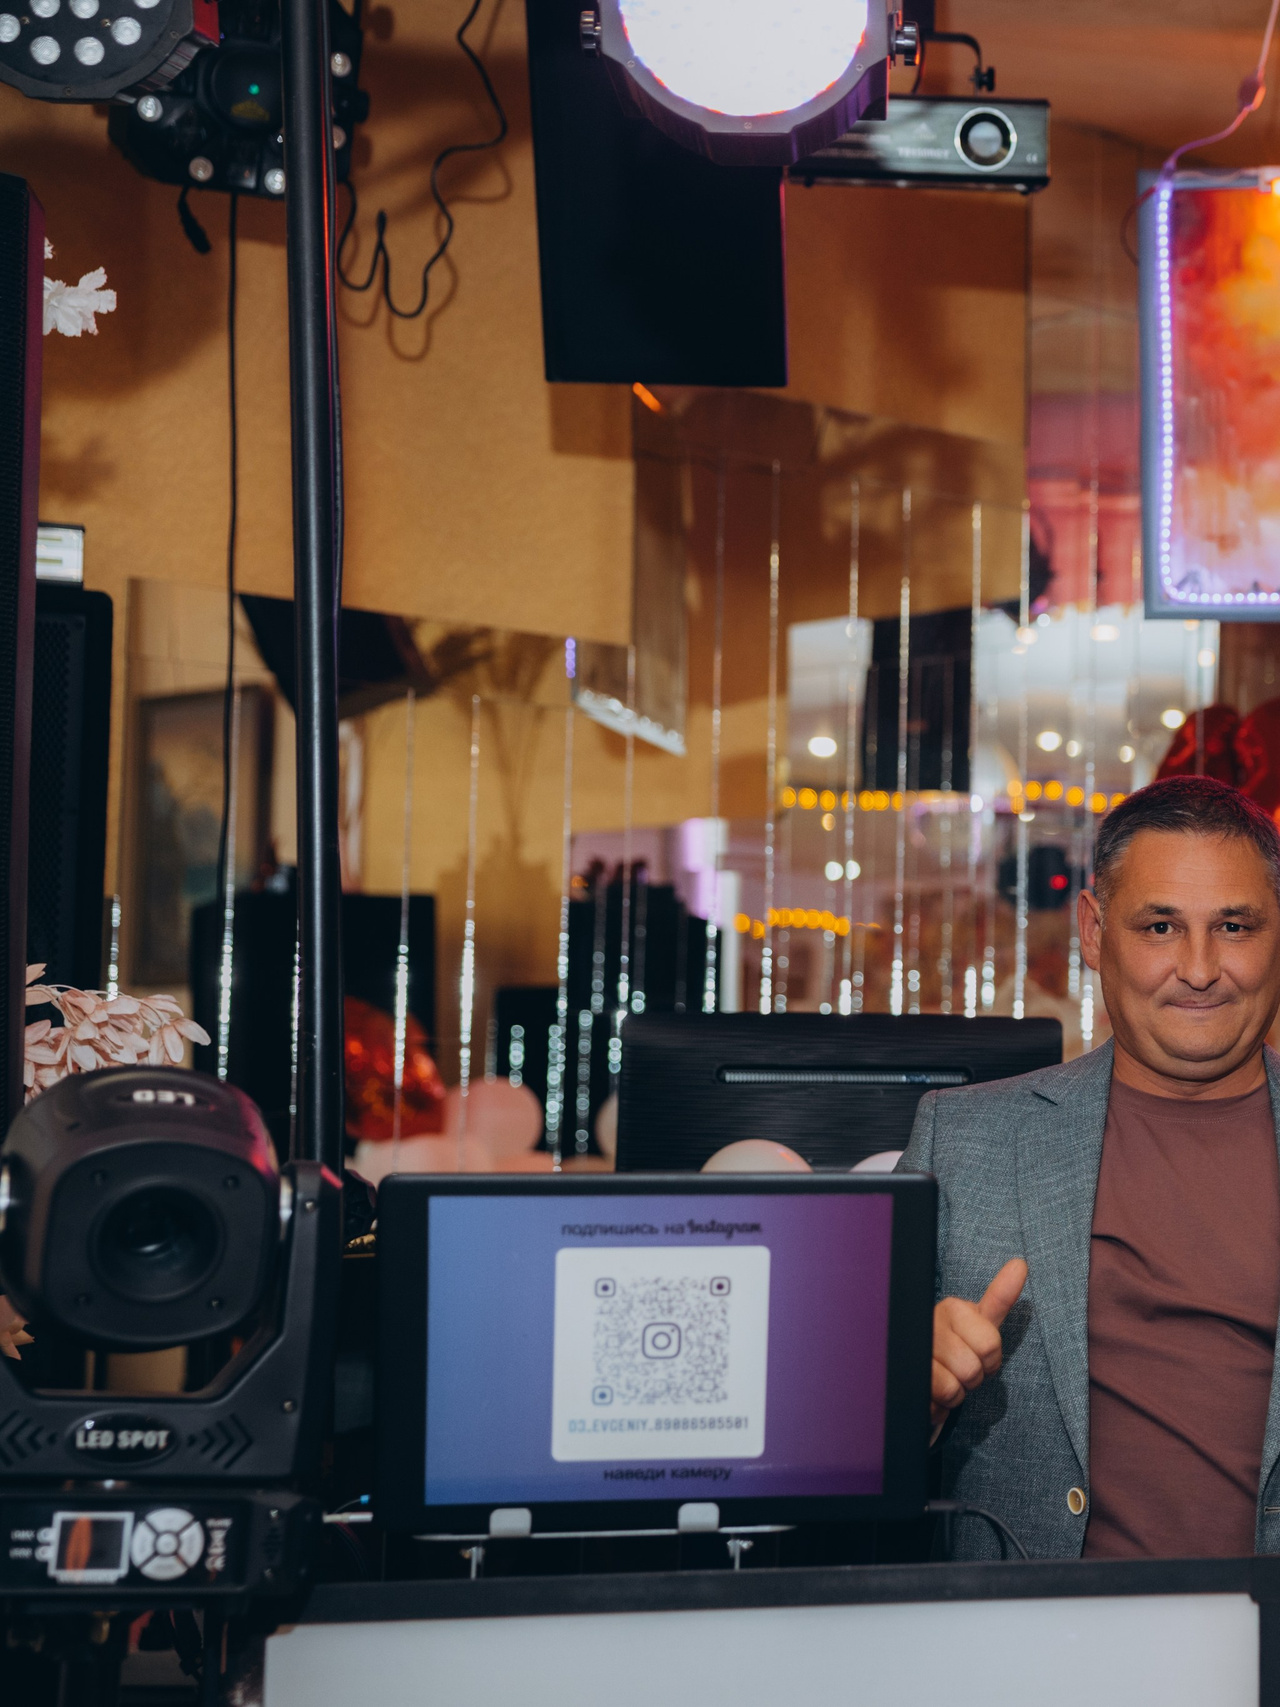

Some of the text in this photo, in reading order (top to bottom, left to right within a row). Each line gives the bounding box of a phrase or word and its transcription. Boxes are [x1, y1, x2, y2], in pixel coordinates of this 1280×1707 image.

[561, 1222, 659, 1237] подпишись
[664, 1222, 685, 1234] на
[76, 1430, 170, 1449] LED SPOT
[603, 1466, 733, 1482] наведи камеру
